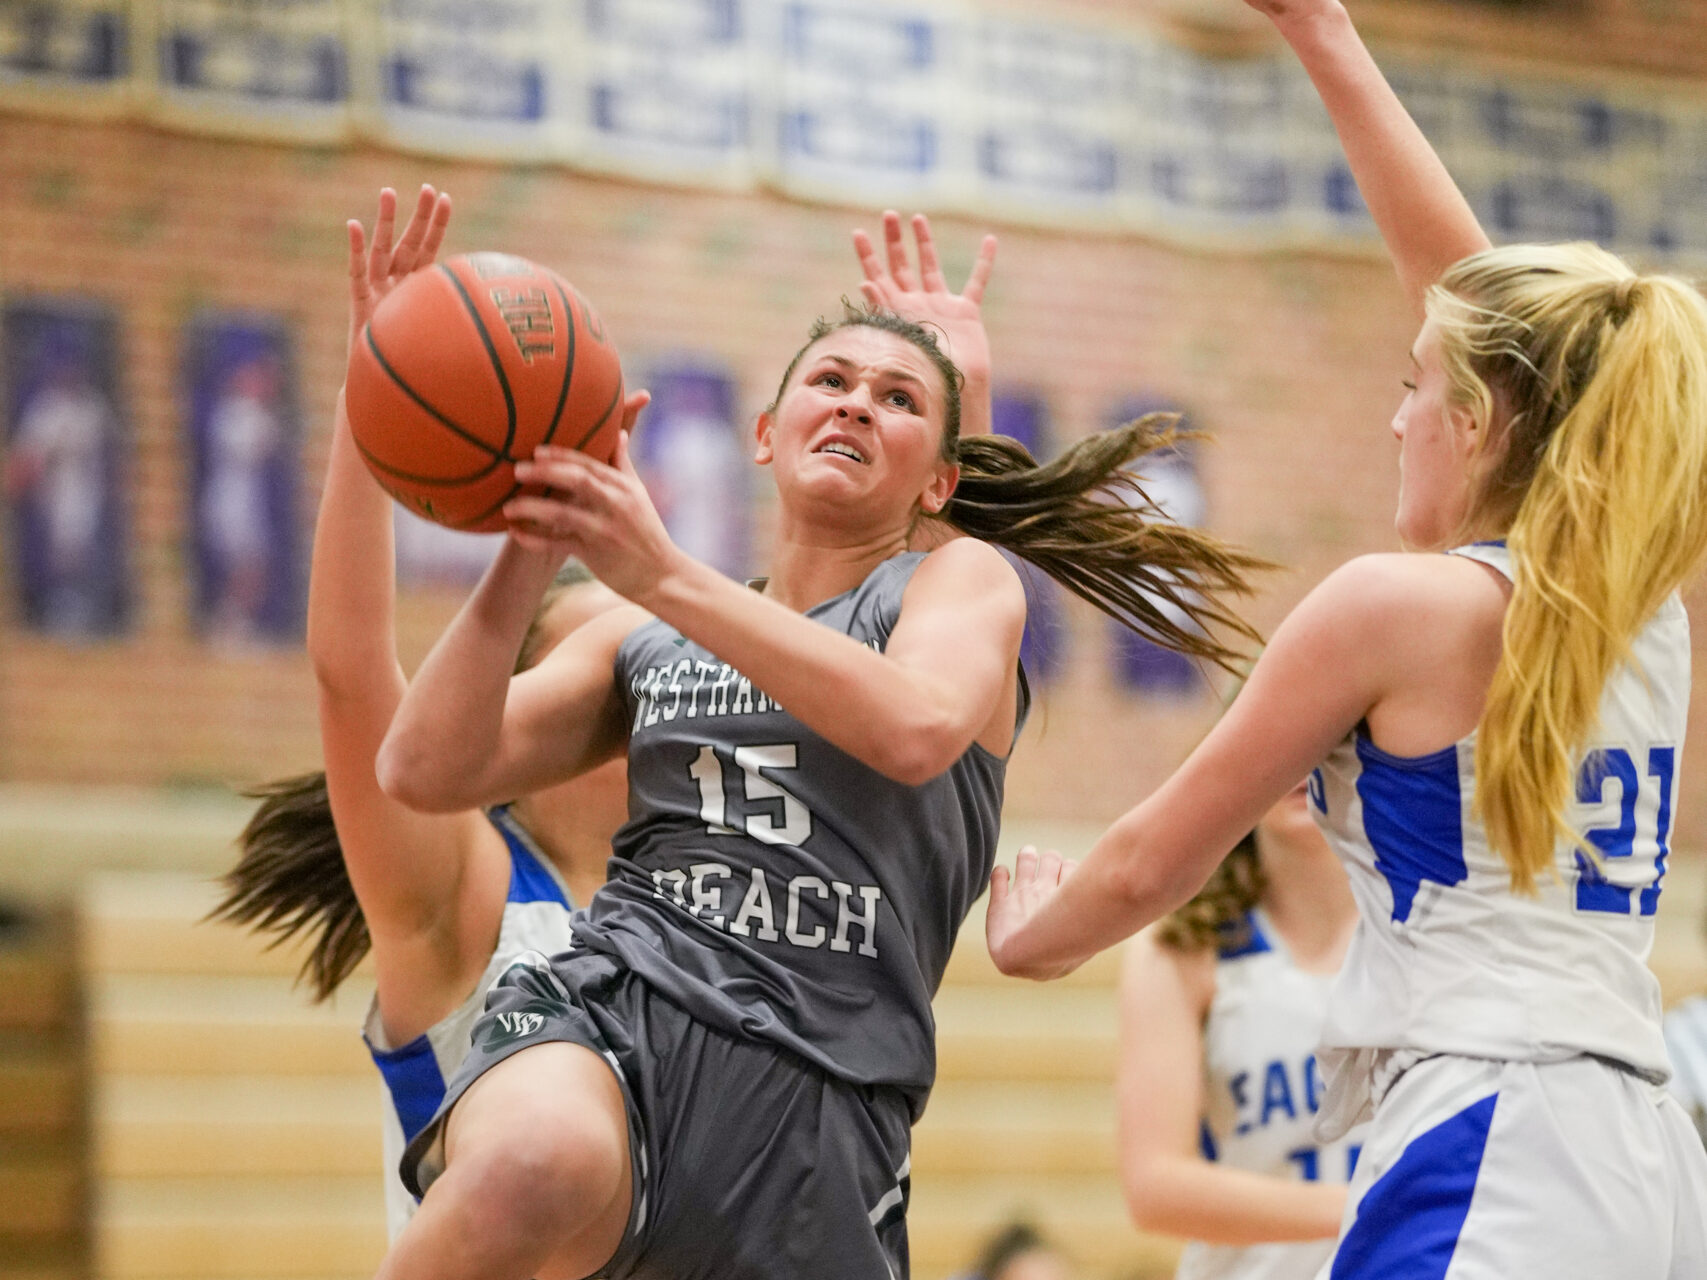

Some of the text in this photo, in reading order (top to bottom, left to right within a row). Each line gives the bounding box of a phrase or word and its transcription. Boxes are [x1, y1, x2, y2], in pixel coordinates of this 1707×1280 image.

[489, 287, 555, 366] THE
[688, 744, 812, 847] 15
[1574, 746, 1675, 917] 21
